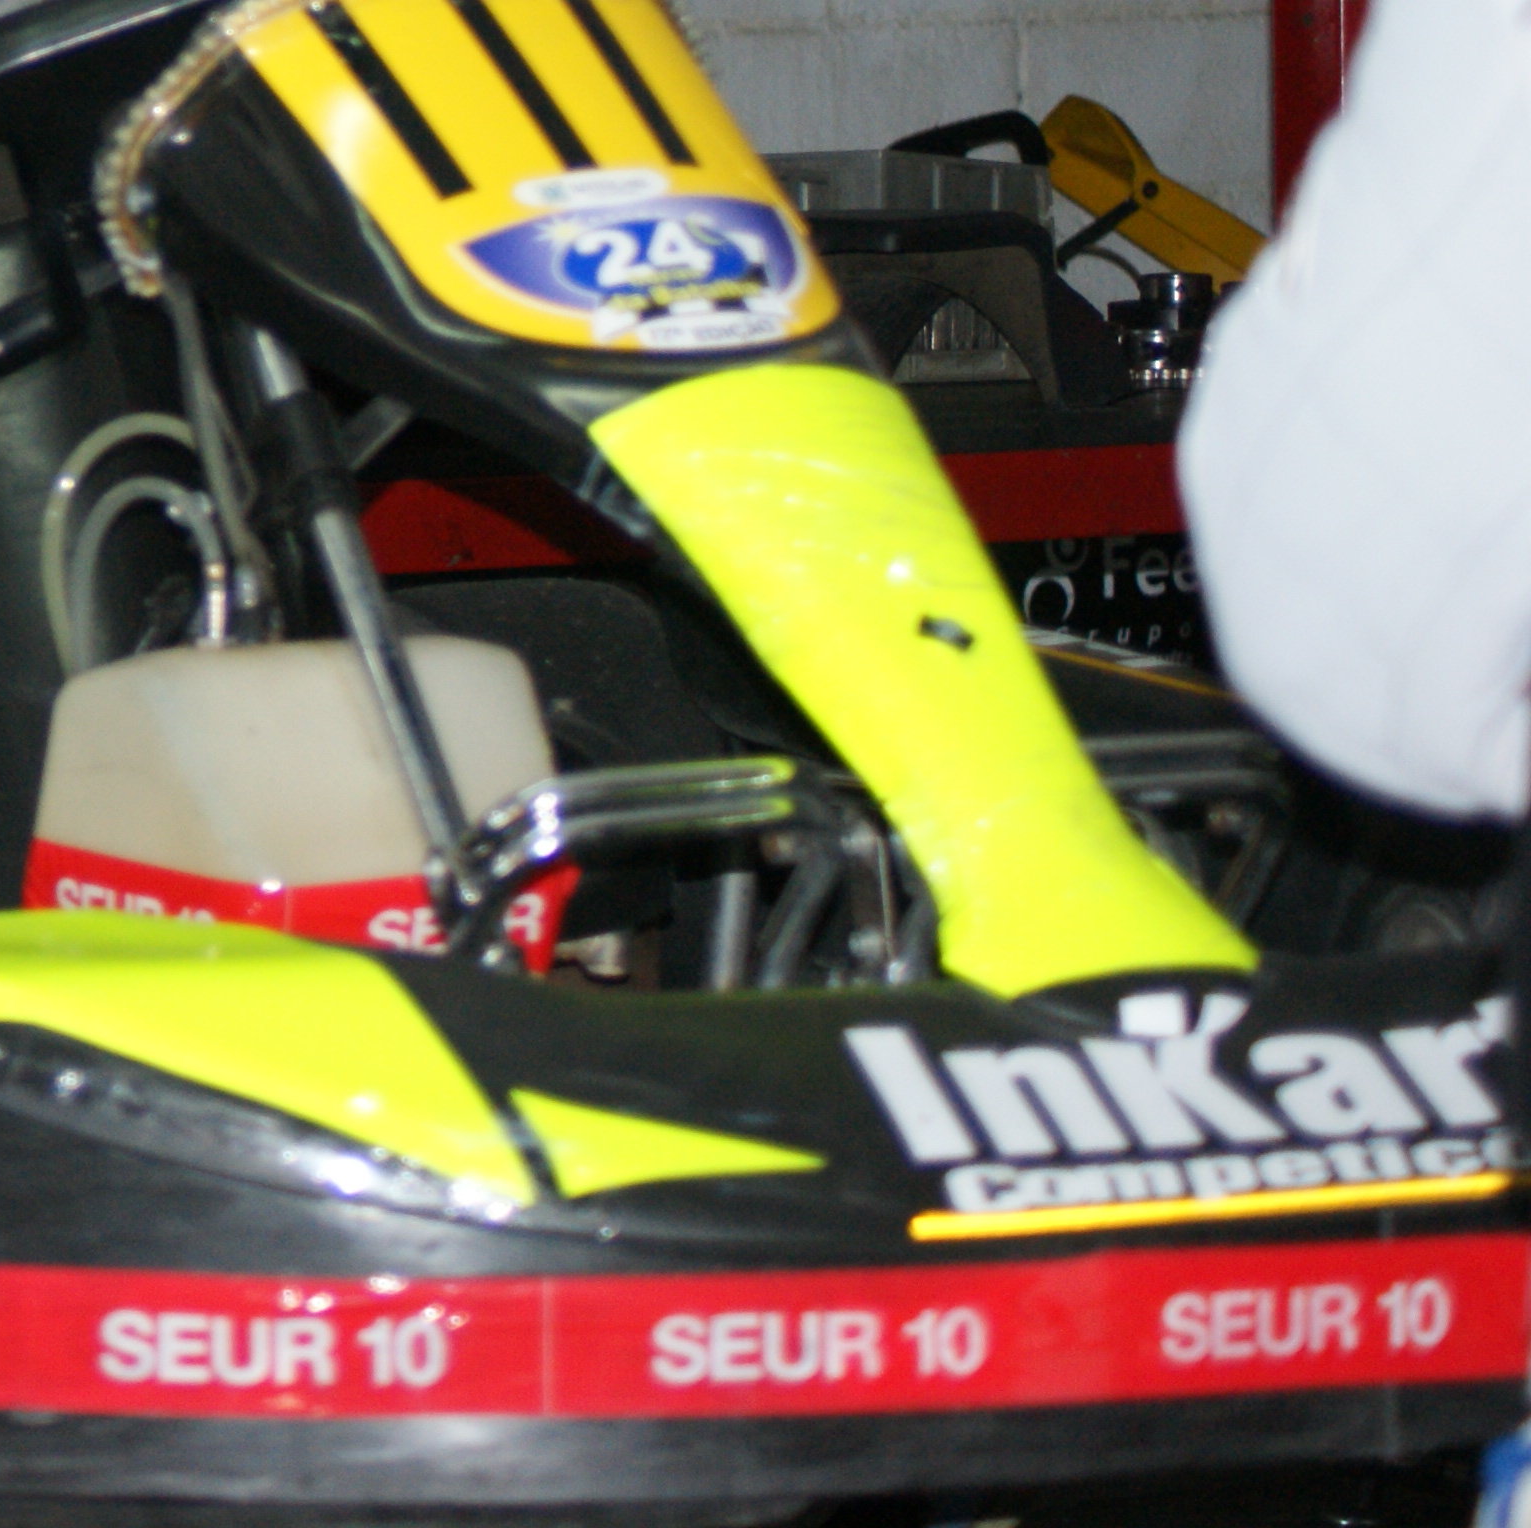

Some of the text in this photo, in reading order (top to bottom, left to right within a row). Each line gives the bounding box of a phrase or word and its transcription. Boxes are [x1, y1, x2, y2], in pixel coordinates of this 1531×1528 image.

[574, 221, 715, 288] 24
[1102, 538, 1199, 600] Fee
[368, 893, 545, 954] SER
[96, 1308, 336, 1388] SEUR
[356, 1316, 448, 1389] 10
[649, 1309, 883, 1387] SEUR
[902, 1305, 988, 1379] 10
[1160, 1283, 1362, 1365] SEUR
[1378, 1277, 1453, 1351] 10
